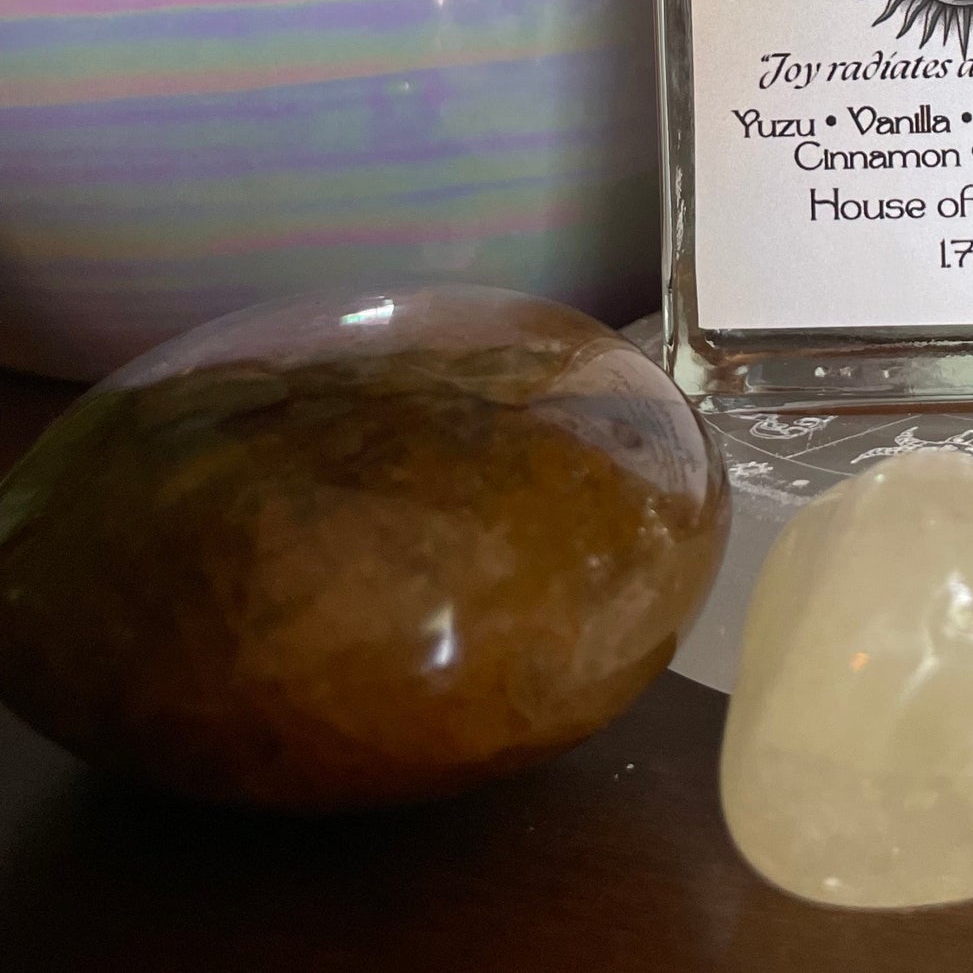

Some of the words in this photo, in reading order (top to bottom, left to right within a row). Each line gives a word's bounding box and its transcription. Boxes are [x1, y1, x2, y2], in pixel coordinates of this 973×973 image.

[826, 49, 953, 82] radiates
[730, 108, 816, 139] Yuzu
[846, 103, 952, 136] Vanilla
[793, 140, 962, 172] Cinnamon
[809, 187, 927, 222] House
